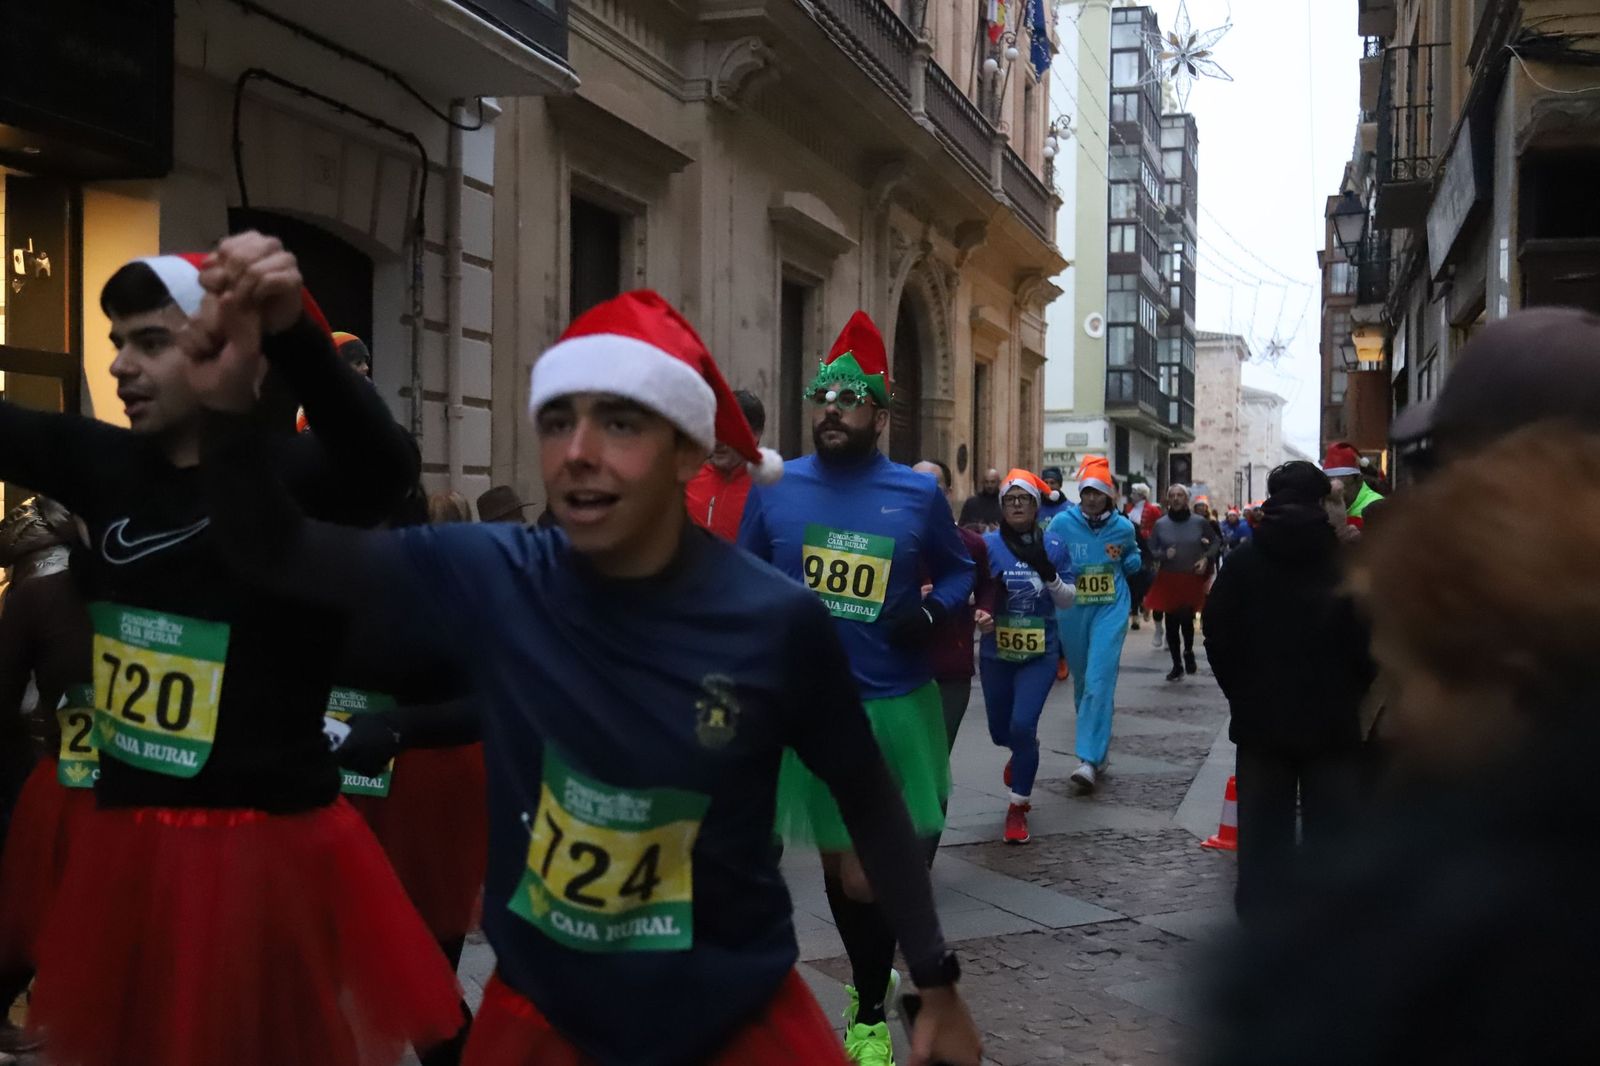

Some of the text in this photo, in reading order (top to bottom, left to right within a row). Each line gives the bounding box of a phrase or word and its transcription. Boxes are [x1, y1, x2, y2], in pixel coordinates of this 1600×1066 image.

[804, 555, 875, 598] 980
[1078, 576, 1109, 593] 405
[821, 599, 877, 617] AJA RURAL
[999, 632, 1038, 651] 565
[102, 652, 195, 731] 720
[115, 731, 199, 769] CAJA RURAL
[343, 774, 385, 789] RURAL
[540, 810, 662, 908] 724
[550, 911, 682, 941] CAJA RURAL
